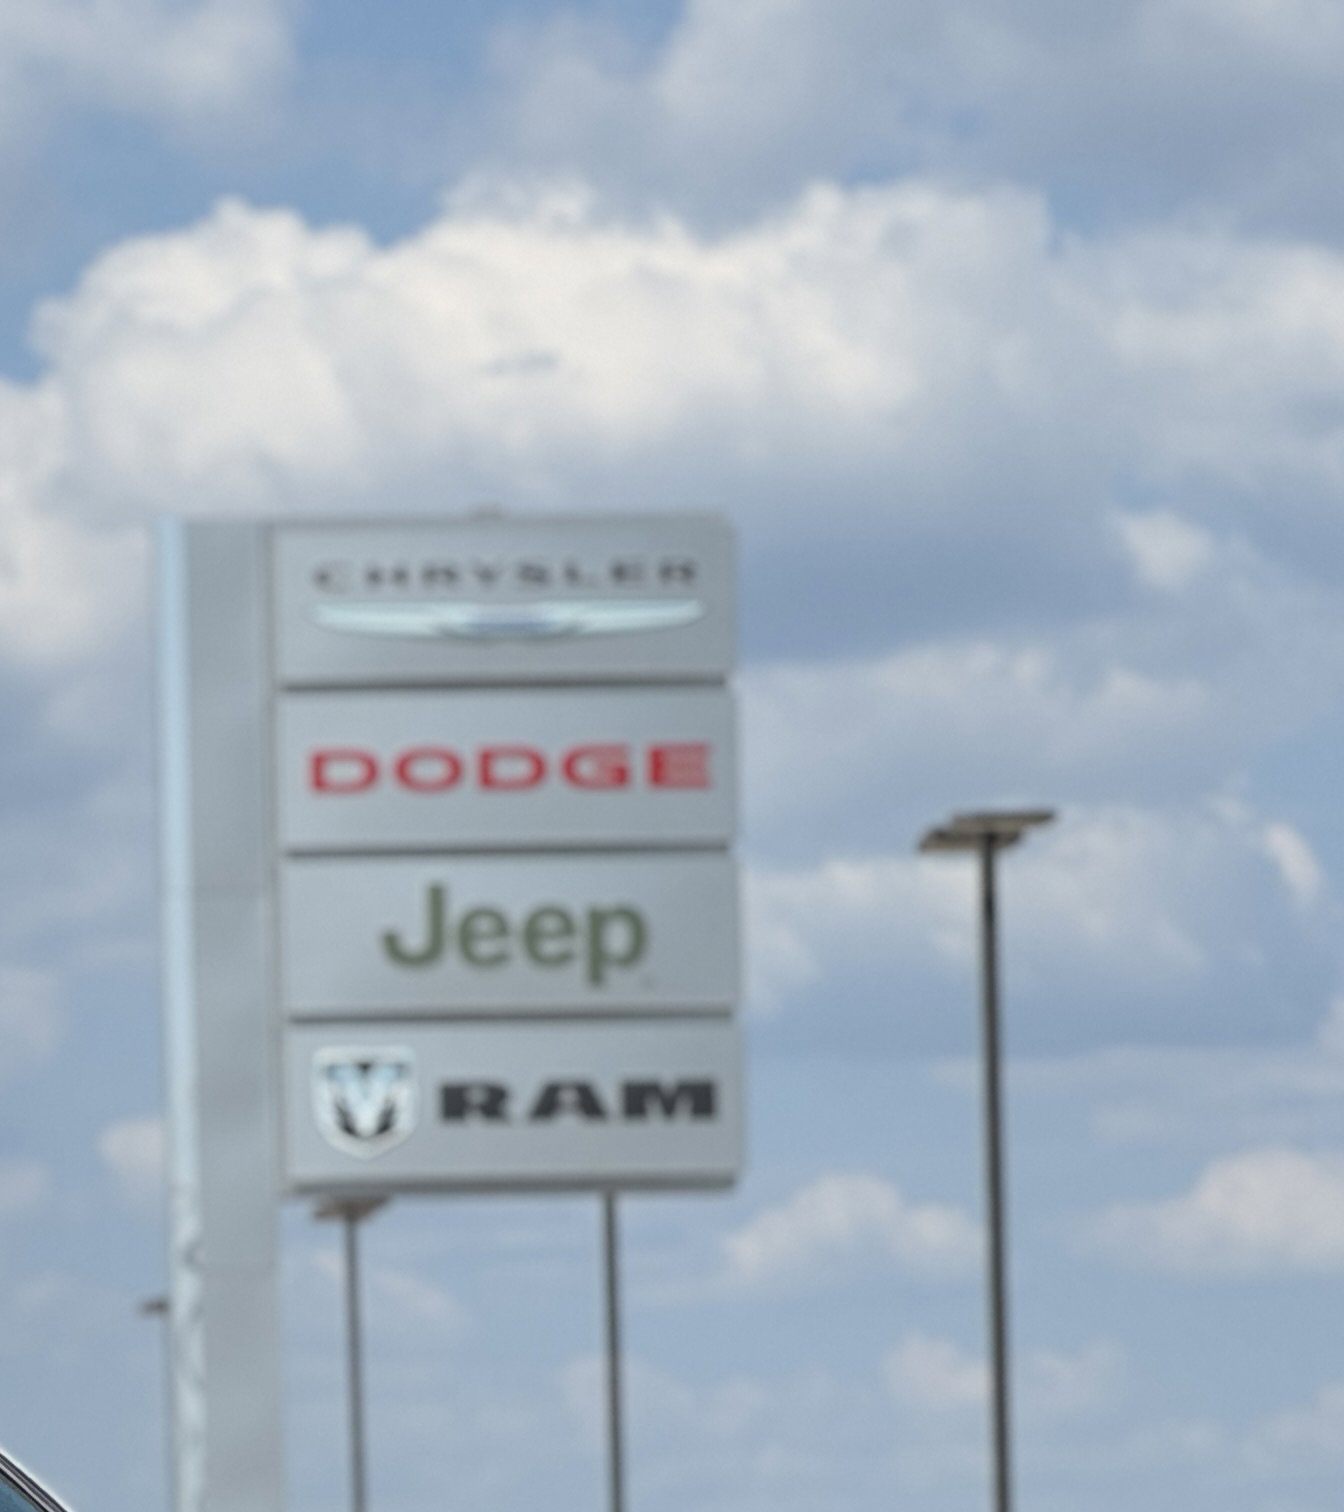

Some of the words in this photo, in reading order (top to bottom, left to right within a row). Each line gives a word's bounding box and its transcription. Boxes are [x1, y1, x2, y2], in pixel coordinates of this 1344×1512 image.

[312, 557, 698, 592] CHRYSLER
[308, 741, 712, 796] DODGE
[380, 883, 648, 987] Jeep
[437, 1079, 719, 1125] RAM
